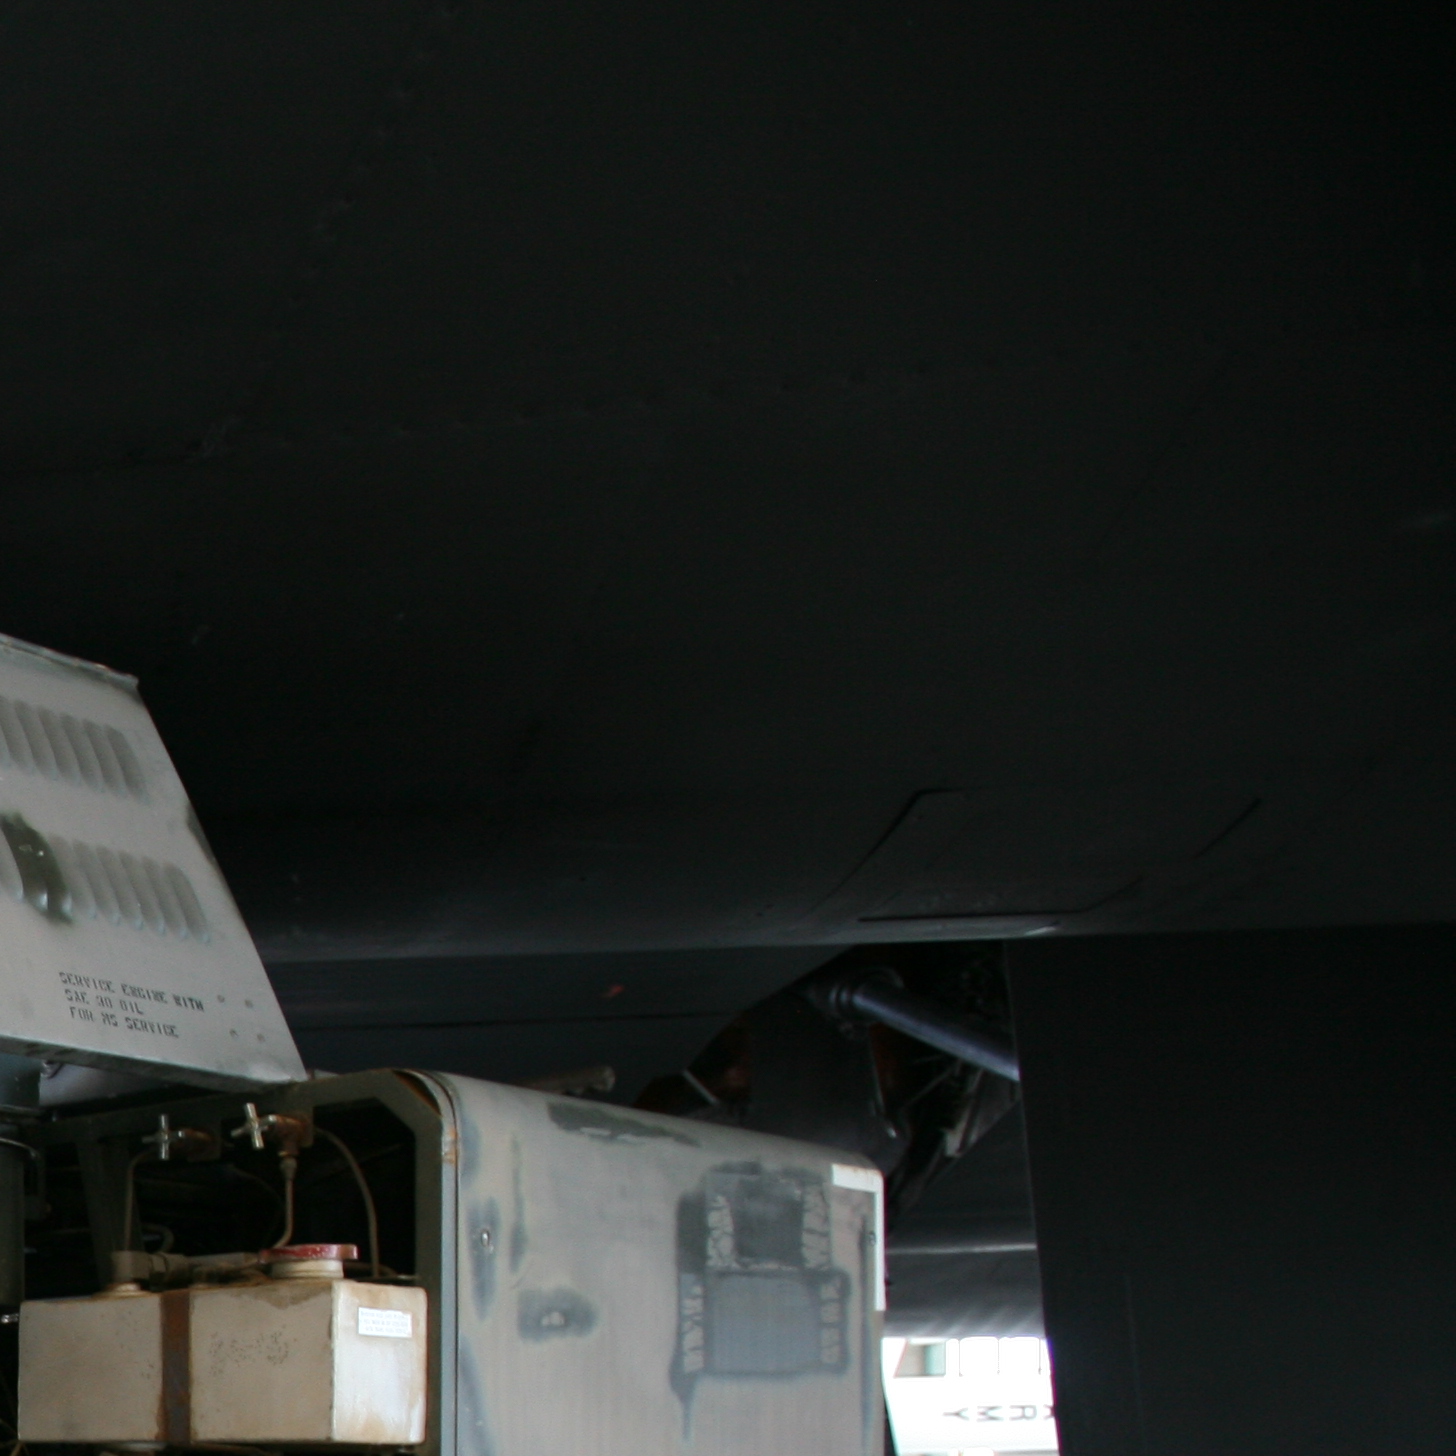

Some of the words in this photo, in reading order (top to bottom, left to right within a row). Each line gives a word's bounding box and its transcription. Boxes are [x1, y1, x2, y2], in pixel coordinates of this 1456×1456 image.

[58, 971, 116, 993] SERVICE
[121, 983, 169, 1006] ENGINE
[173, 993, 205, 1013] WITH
[64, 988, 90, 1006] SAE
[120, 998, 145, 1016] OIL
[69, 1006, 96, 1023] FOR
[125, 1016, 180, 1040] SERVICE
